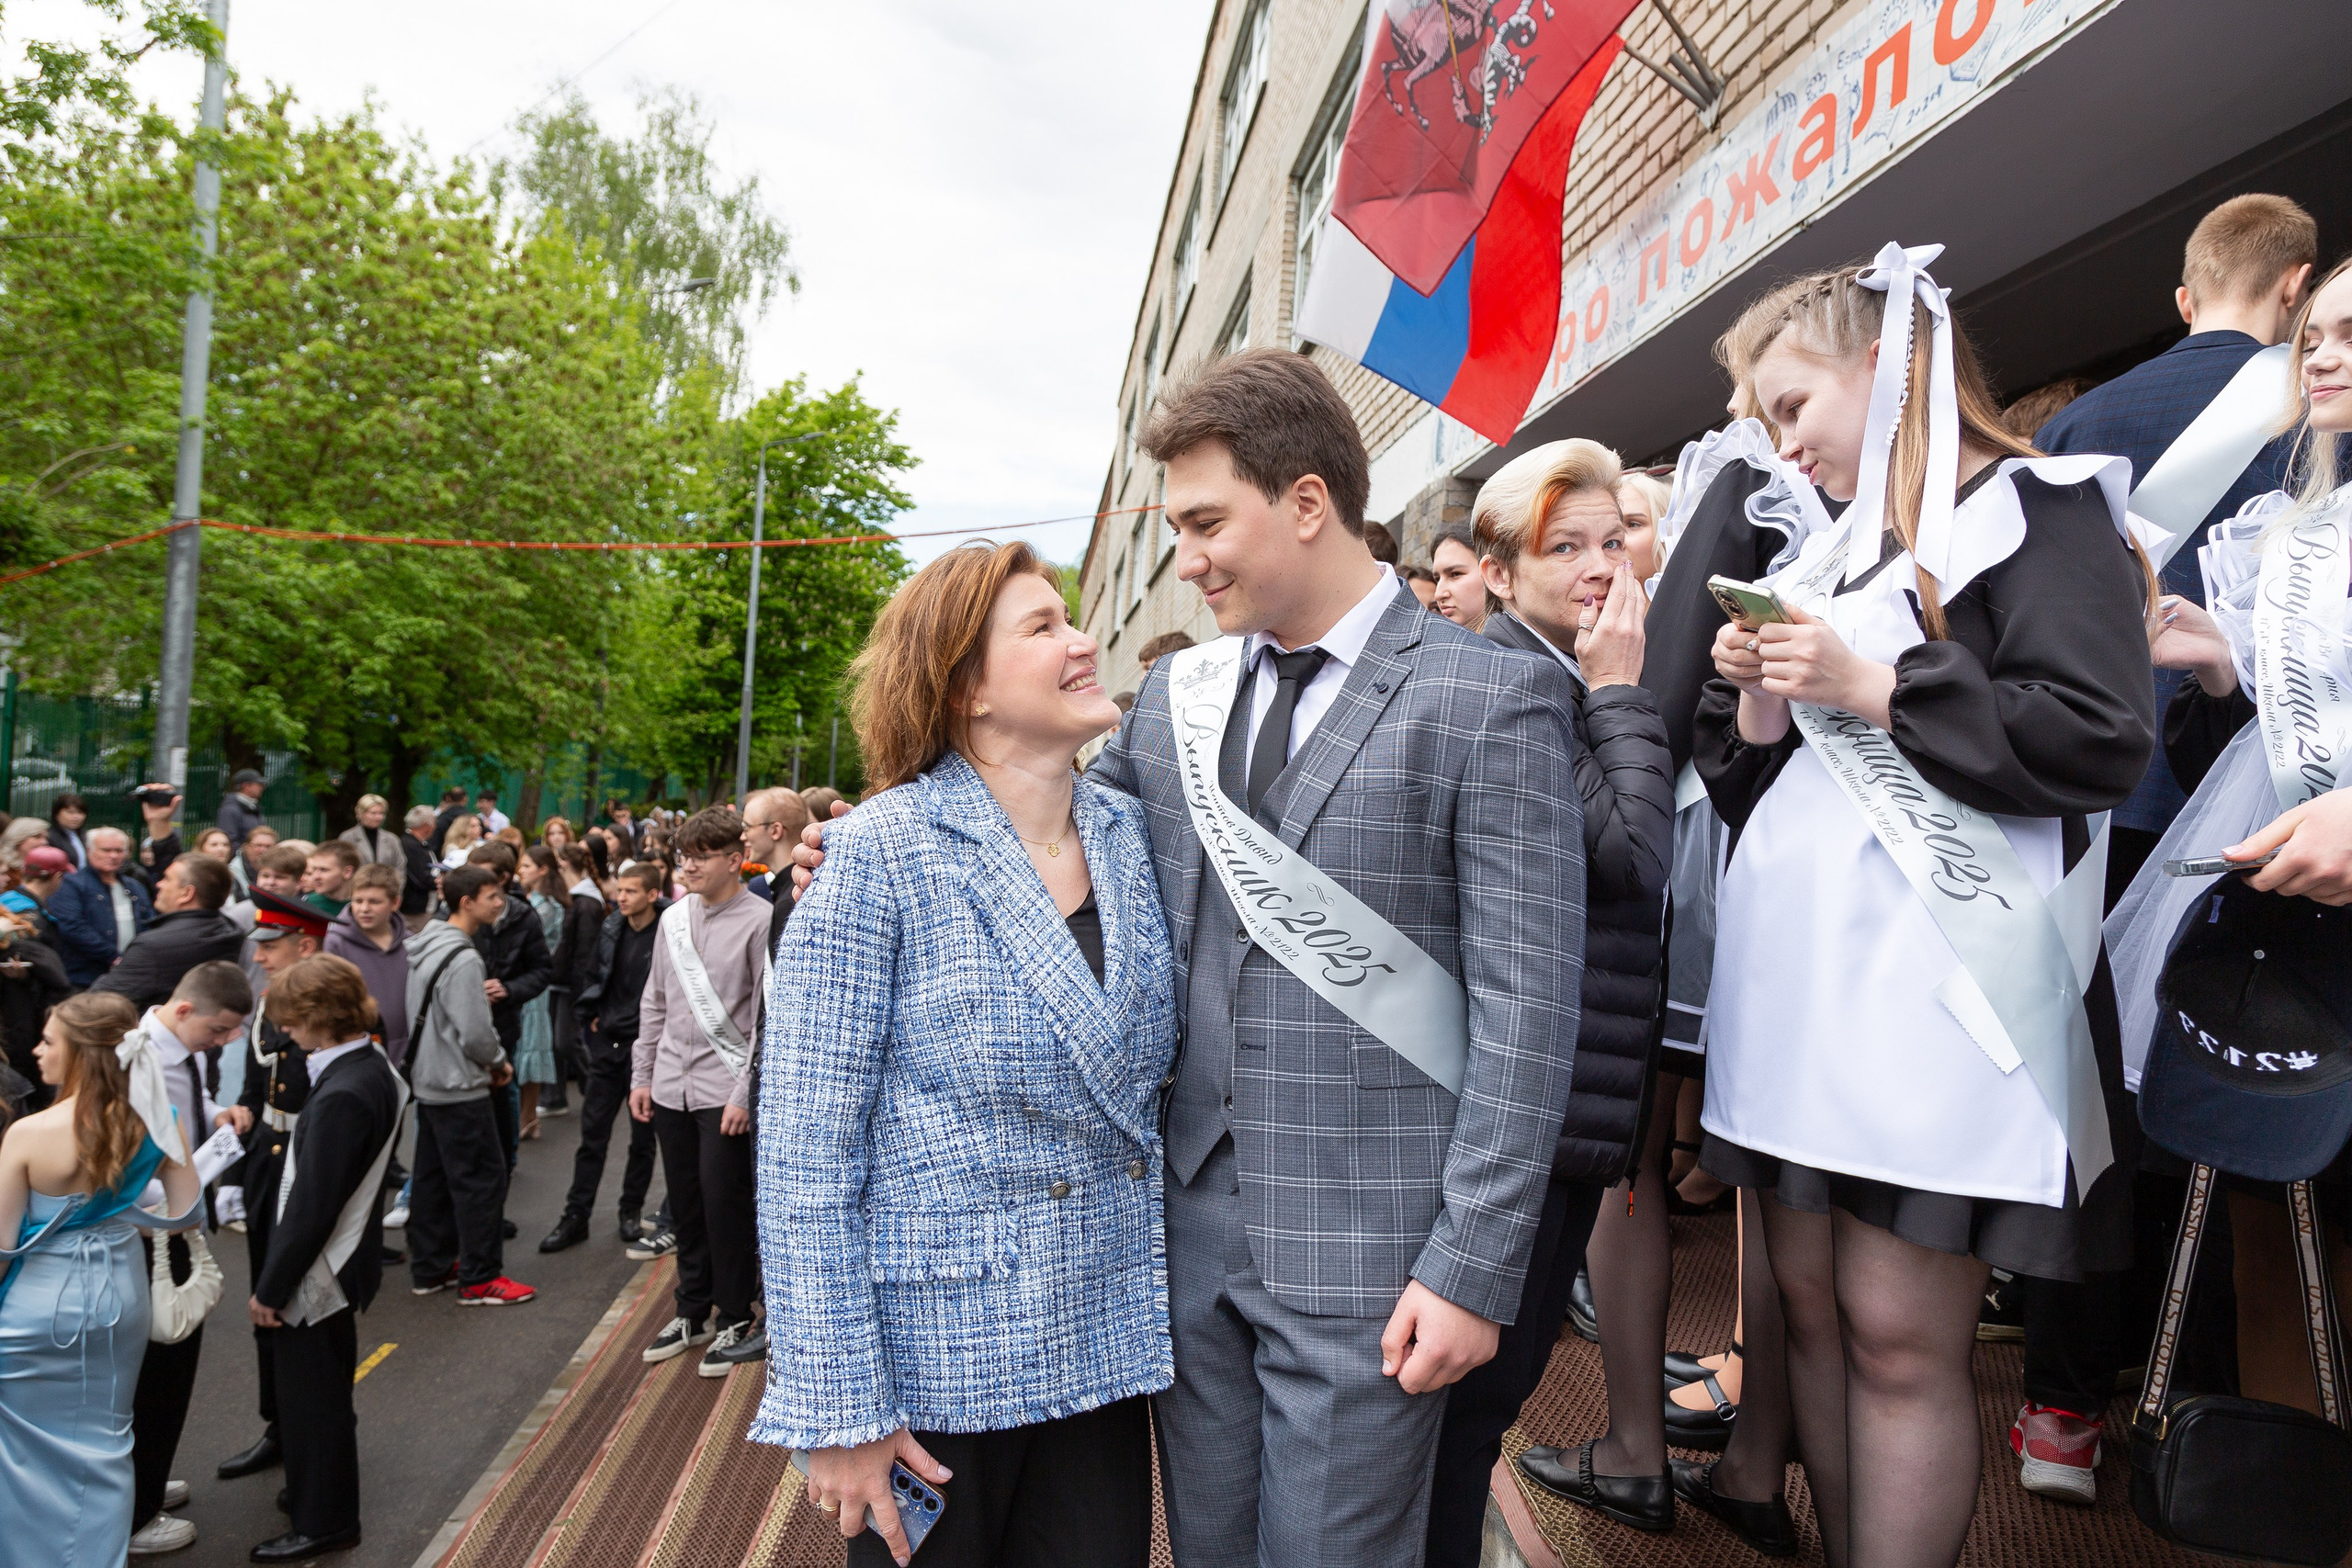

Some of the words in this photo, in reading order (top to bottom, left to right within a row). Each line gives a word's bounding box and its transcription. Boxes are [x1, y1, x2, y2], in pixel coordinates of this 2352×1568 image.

[1637, 0, 2035, 307] пожало
[2261, 682, 2277, 723] Школа
[2269, 725, 2286, 769] №2122
[1819, 741, 1844, 769] класс,
[1840, 767, 1871, 805] Школа
[1865, 804, 1905, 846] №2122
[1179, 704, 1294, 909] Выпускник
[1272, 911, 1398, 987] 2025
[1232, 828, 1284, 865] Давид
[1898, 807, 2014, 910] 2025
[1230, 886, 1257, 924] Школа
[1253, 924, 1300, 962] №2122
[2164, 1288, 2185, 1325] U.S.
[2308, 1285, 2324, 1321] U.S.
[2151, 1330, 2176, 1387] POLO
[2312, 1325, 2334, 1382] POLO
